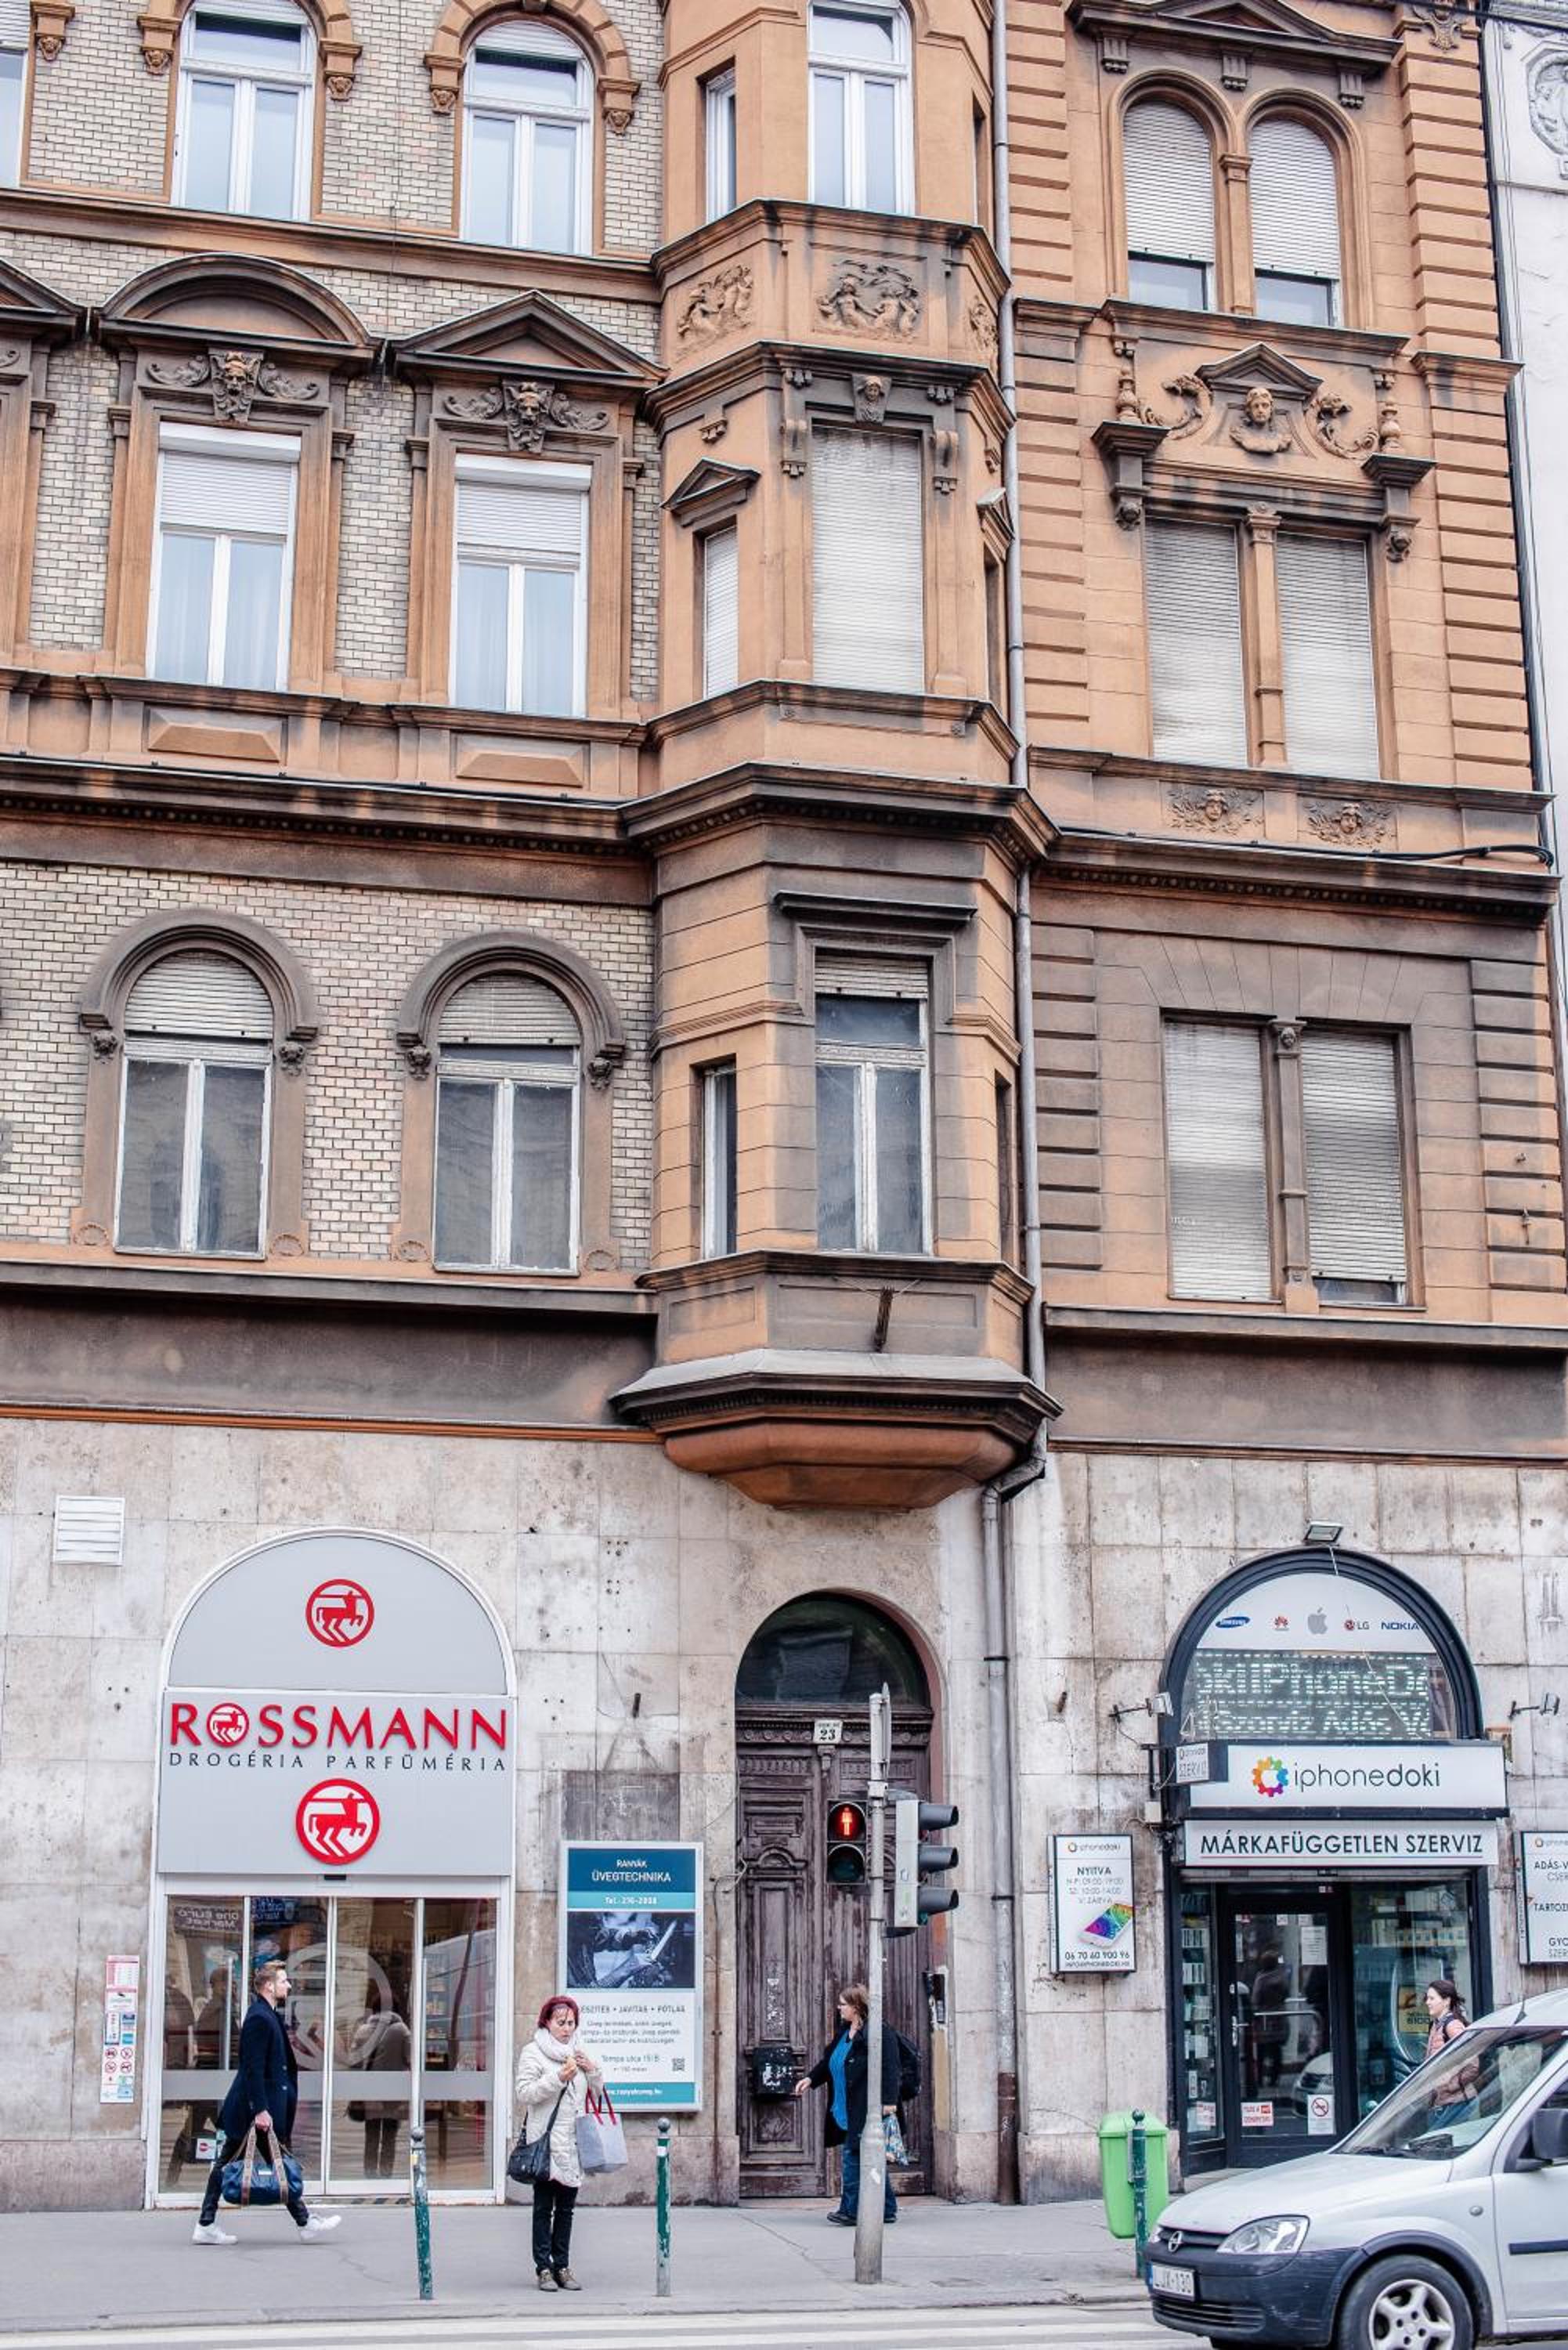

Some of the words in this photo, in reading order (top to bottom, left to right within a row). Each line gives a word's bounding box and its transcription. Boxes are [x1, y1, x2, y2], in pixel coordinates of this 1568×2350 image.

[1381, 1622, 1420, 1630] NOKIA
[170, 1702, 507, 1751] ROSSMANN
[819, 1729, 836, 1741] 23
[169, 1751, 304, 1768] DROGÉRIA
[1294, 1762, 1440, 1792] iphonedoki
[1201, 1830, 1399, 1854] MÁRKAFÜGGETLEN
[1406, 1834, 1483, 1853] SZERVIZ
[591, 1869, 672, 1882] ÜVEGTECHNIKA
[1077, 1867, 1111, 1875] NYITVA
